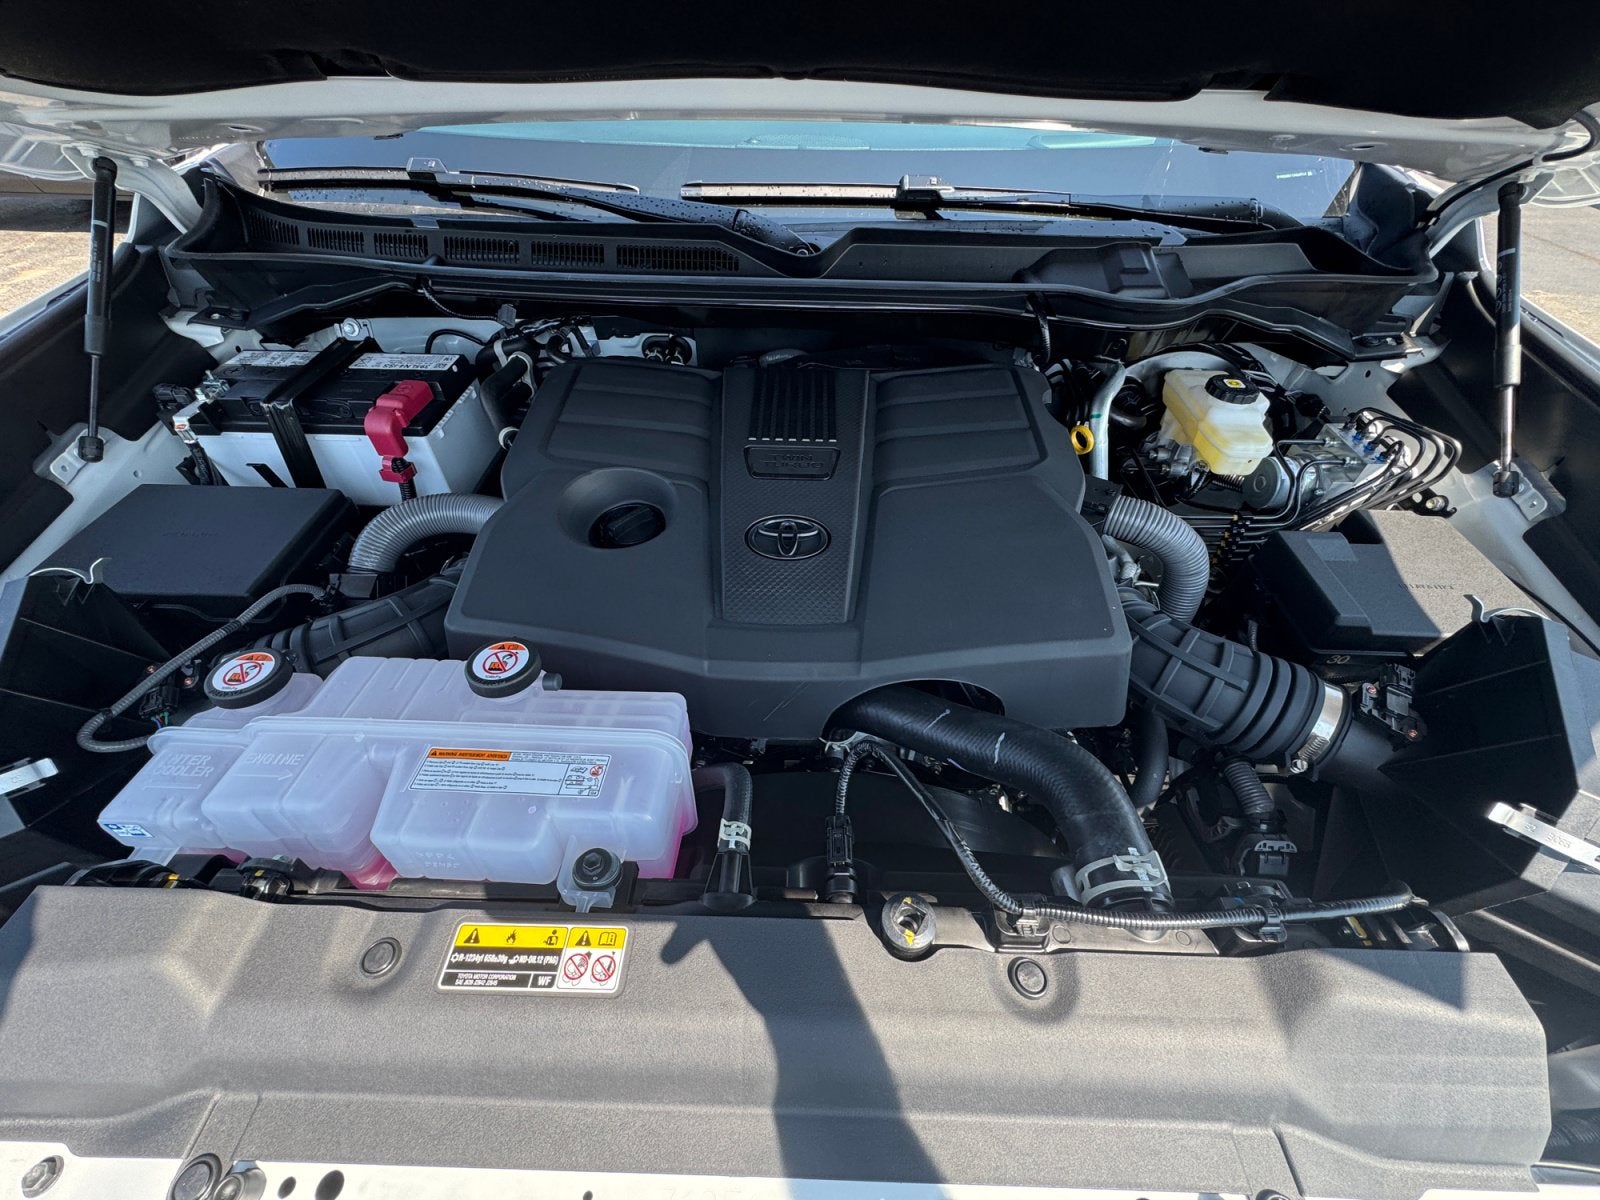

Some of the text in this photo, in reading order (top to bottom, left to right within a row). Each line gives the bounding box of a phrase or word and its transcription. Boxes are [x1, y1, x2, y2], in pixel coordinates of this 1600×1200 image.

[163, 752, 212, 766] INTER
[244, 753, 305, 766] ENGINE
[154, 765, 215, 778] COOLER
[537, 975, 553, 986] WF
